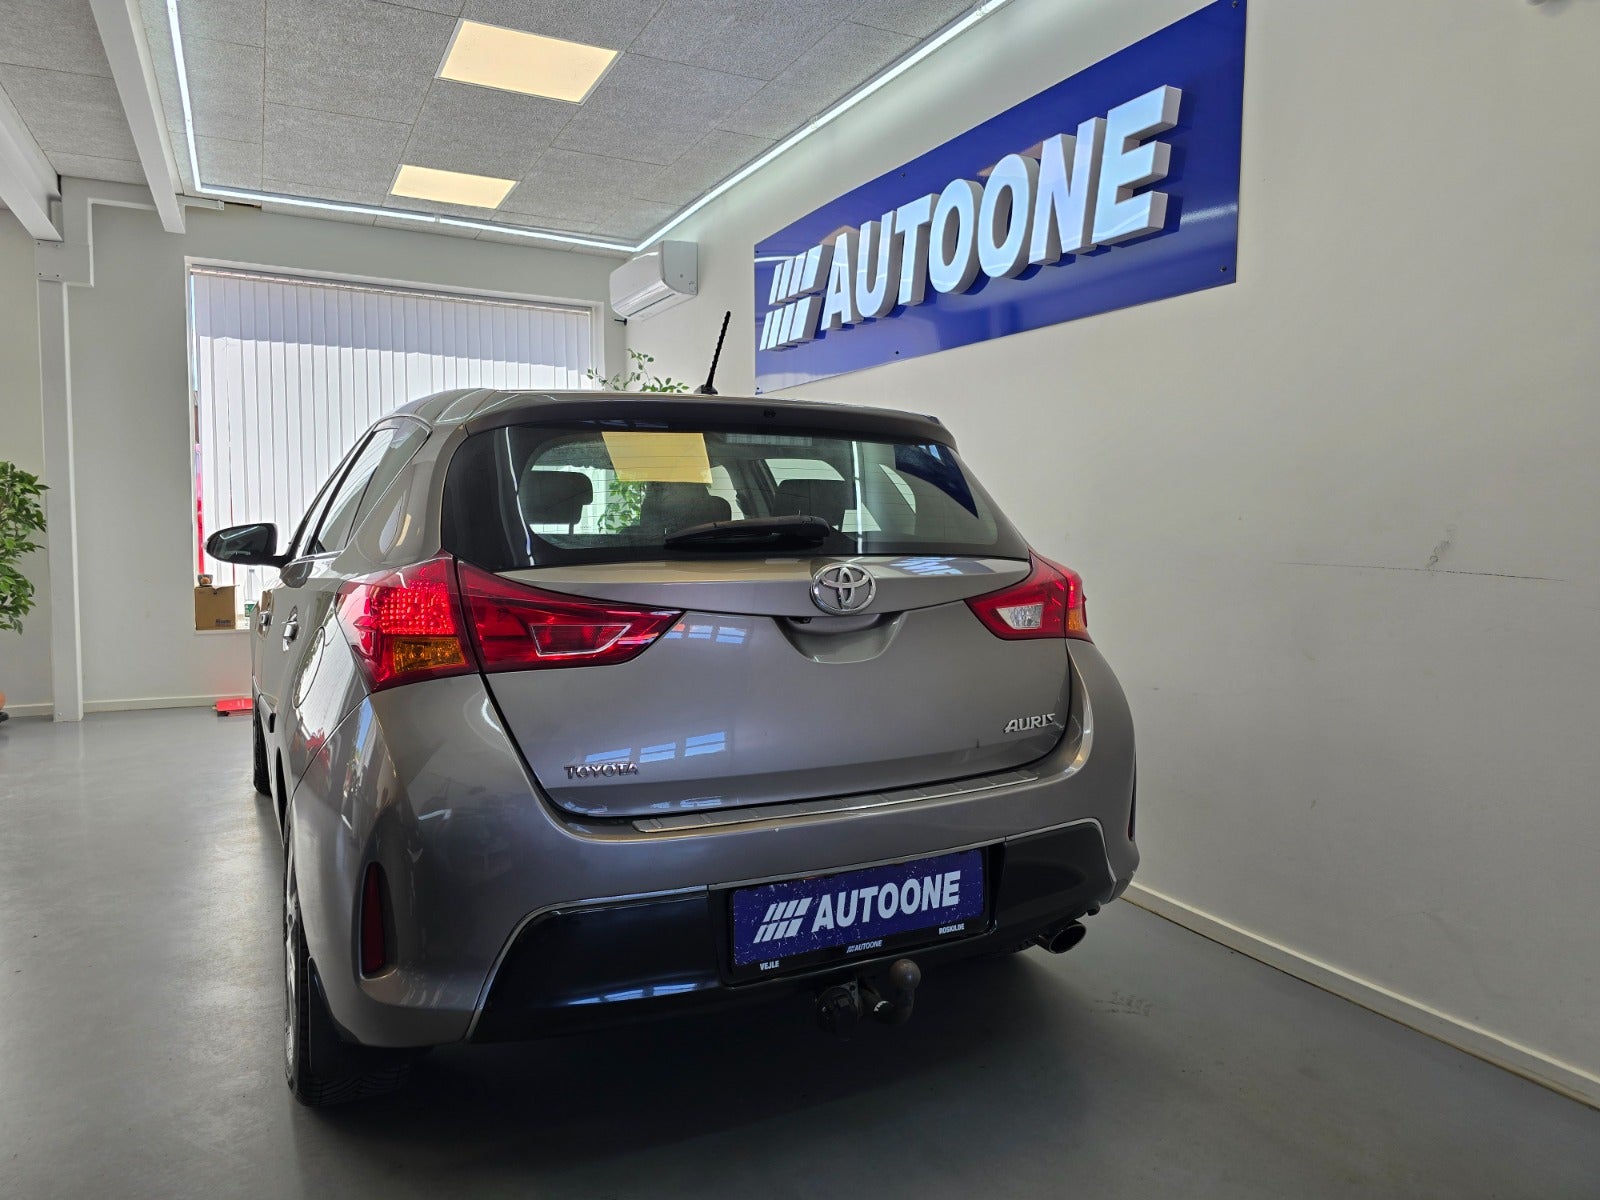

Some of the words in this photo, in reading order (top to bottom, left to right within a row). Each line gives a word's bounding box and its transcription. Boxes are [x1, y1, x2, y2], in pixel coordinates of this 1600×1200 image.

[820, 84, 1183, 331] AUTOONE
[563, 761, 639, 779] TOYOTA
[810, 870, 961, 933] AUTOONE
[938, 922, 965, 935] ROSKILDE
[854, 939, 883, 952] AUTOONE
[759, 960, 780, 971] VEJLE
